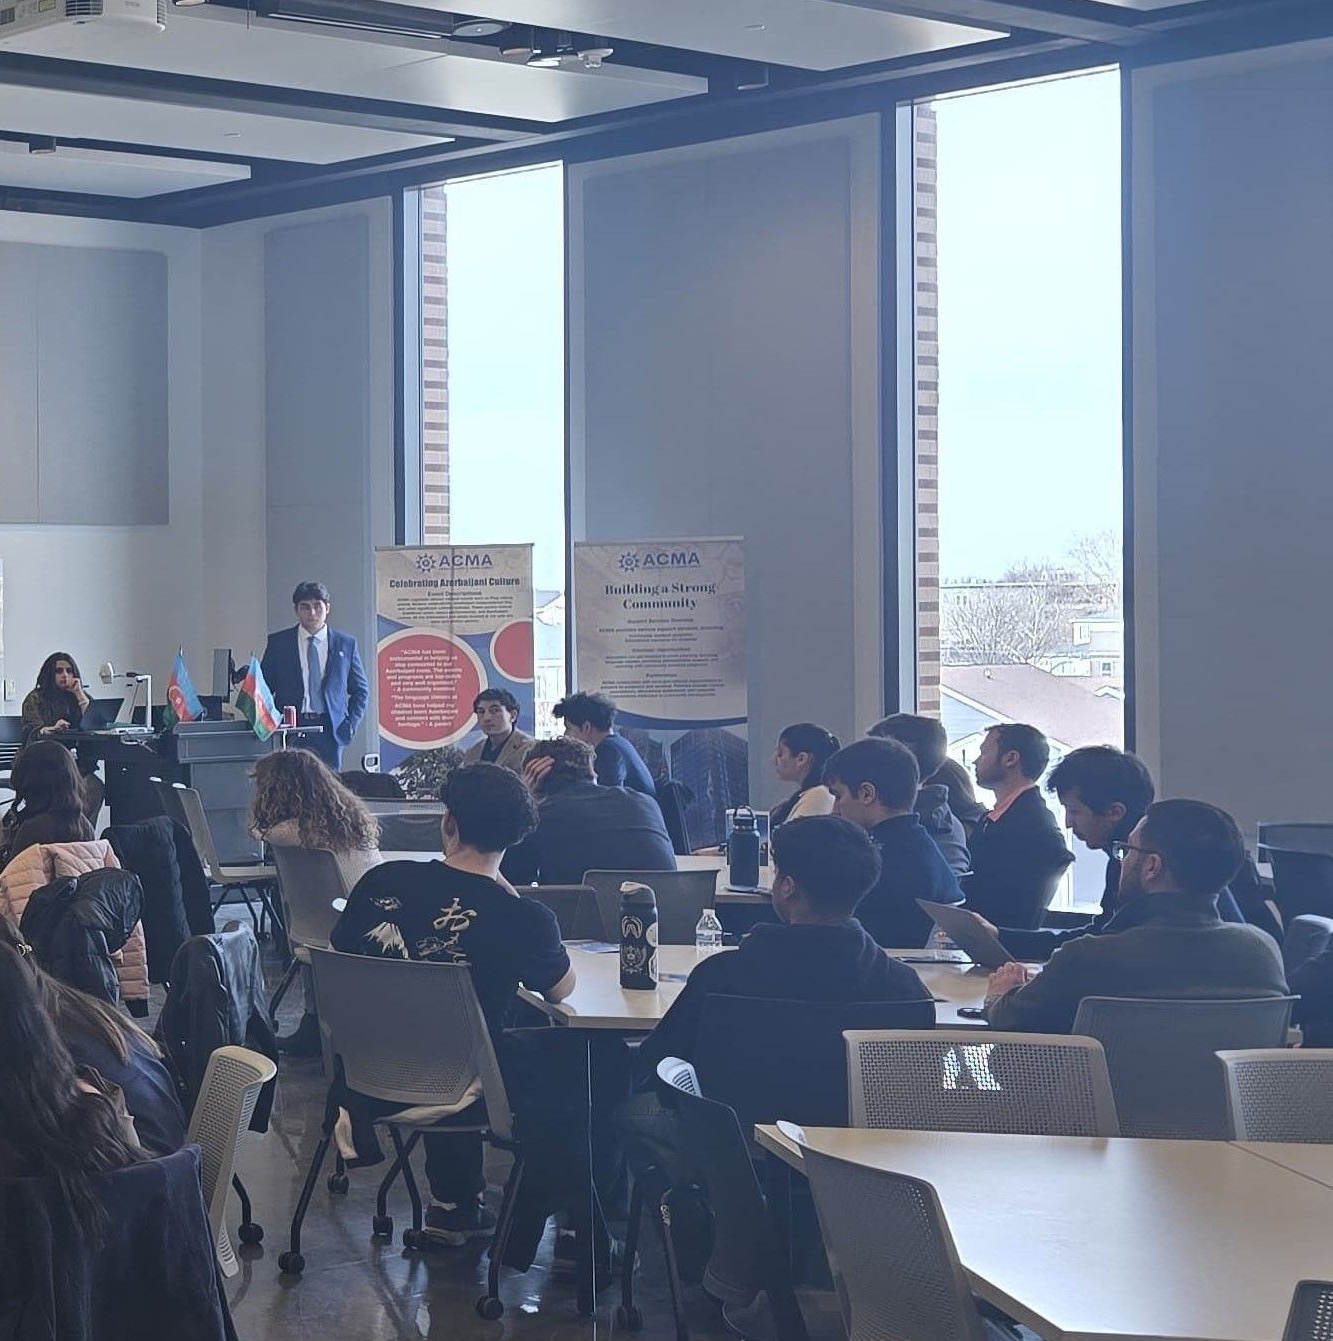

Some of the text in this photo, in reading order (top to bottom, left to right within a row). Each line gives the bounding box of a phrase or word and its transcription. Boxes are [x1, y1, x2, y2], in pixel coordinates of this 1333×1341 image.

[439, 554, 493, 567] ACMA
[643, 552, 700, 566] ACMA
[389, 577, 520, 588] Celebrating Azerbaijani Culture
[605, 584, 659, 596] Building
[671, 582, 716, 594] Strong
[623, 598, 697, 610] Community
